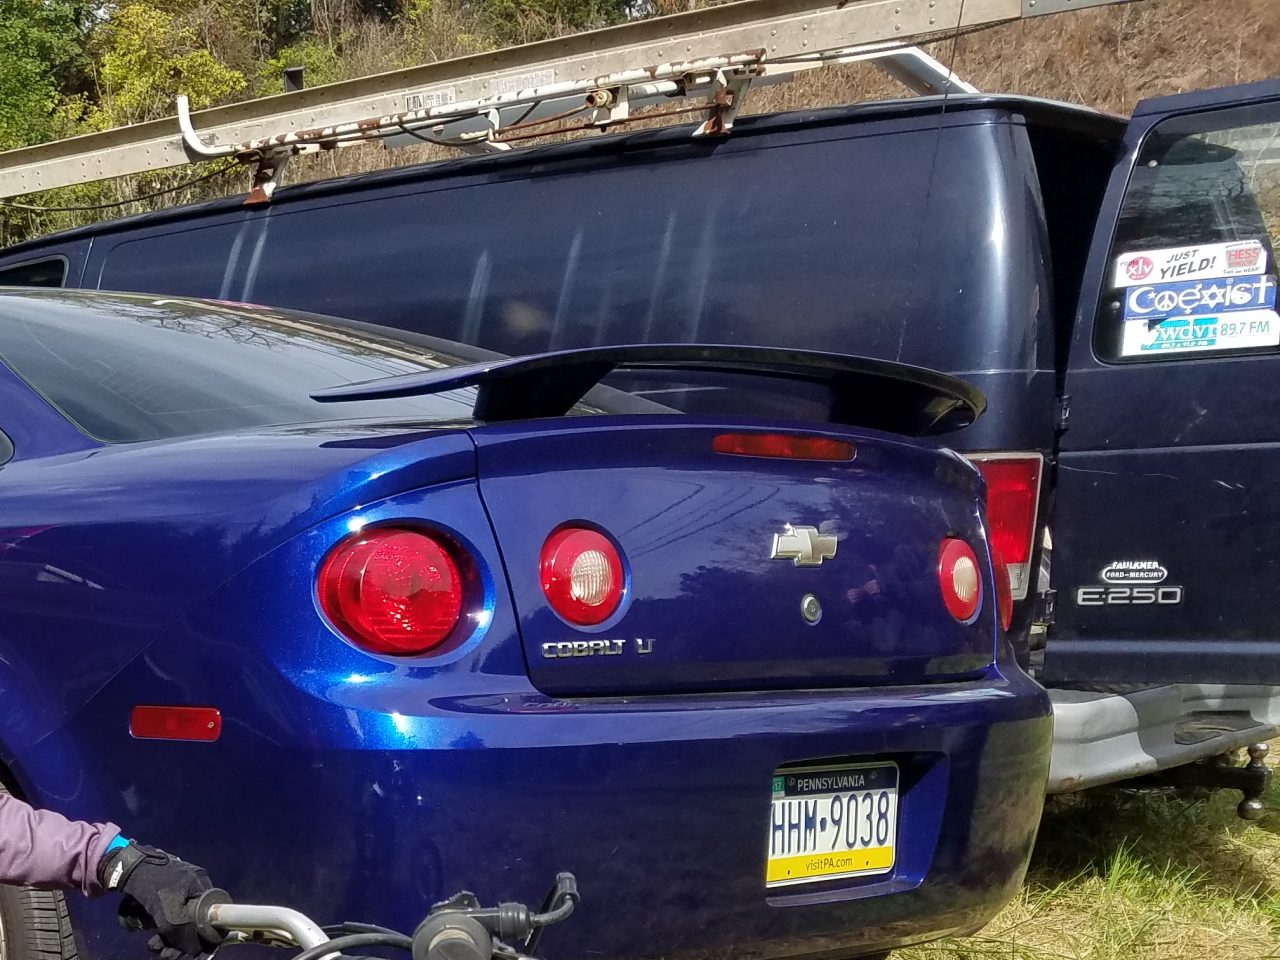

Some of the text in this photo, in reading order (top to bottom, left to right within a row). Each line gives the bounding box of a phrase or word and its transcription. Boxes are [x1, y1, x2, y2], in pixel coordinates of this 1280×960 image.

[1166, 248, 1199, 264] JUST
[1160, 256, 1217, 280] YIELD!
[1220, 320, 1270, 336] 89.7 FM
[1112, 561, 1160, 569] FAULKNER
[543, 639, 626, 658] COBALT
[797, 775, 865, 791] PENNSYLVANIA
[805, 857, 853, 871] visitPA.com
